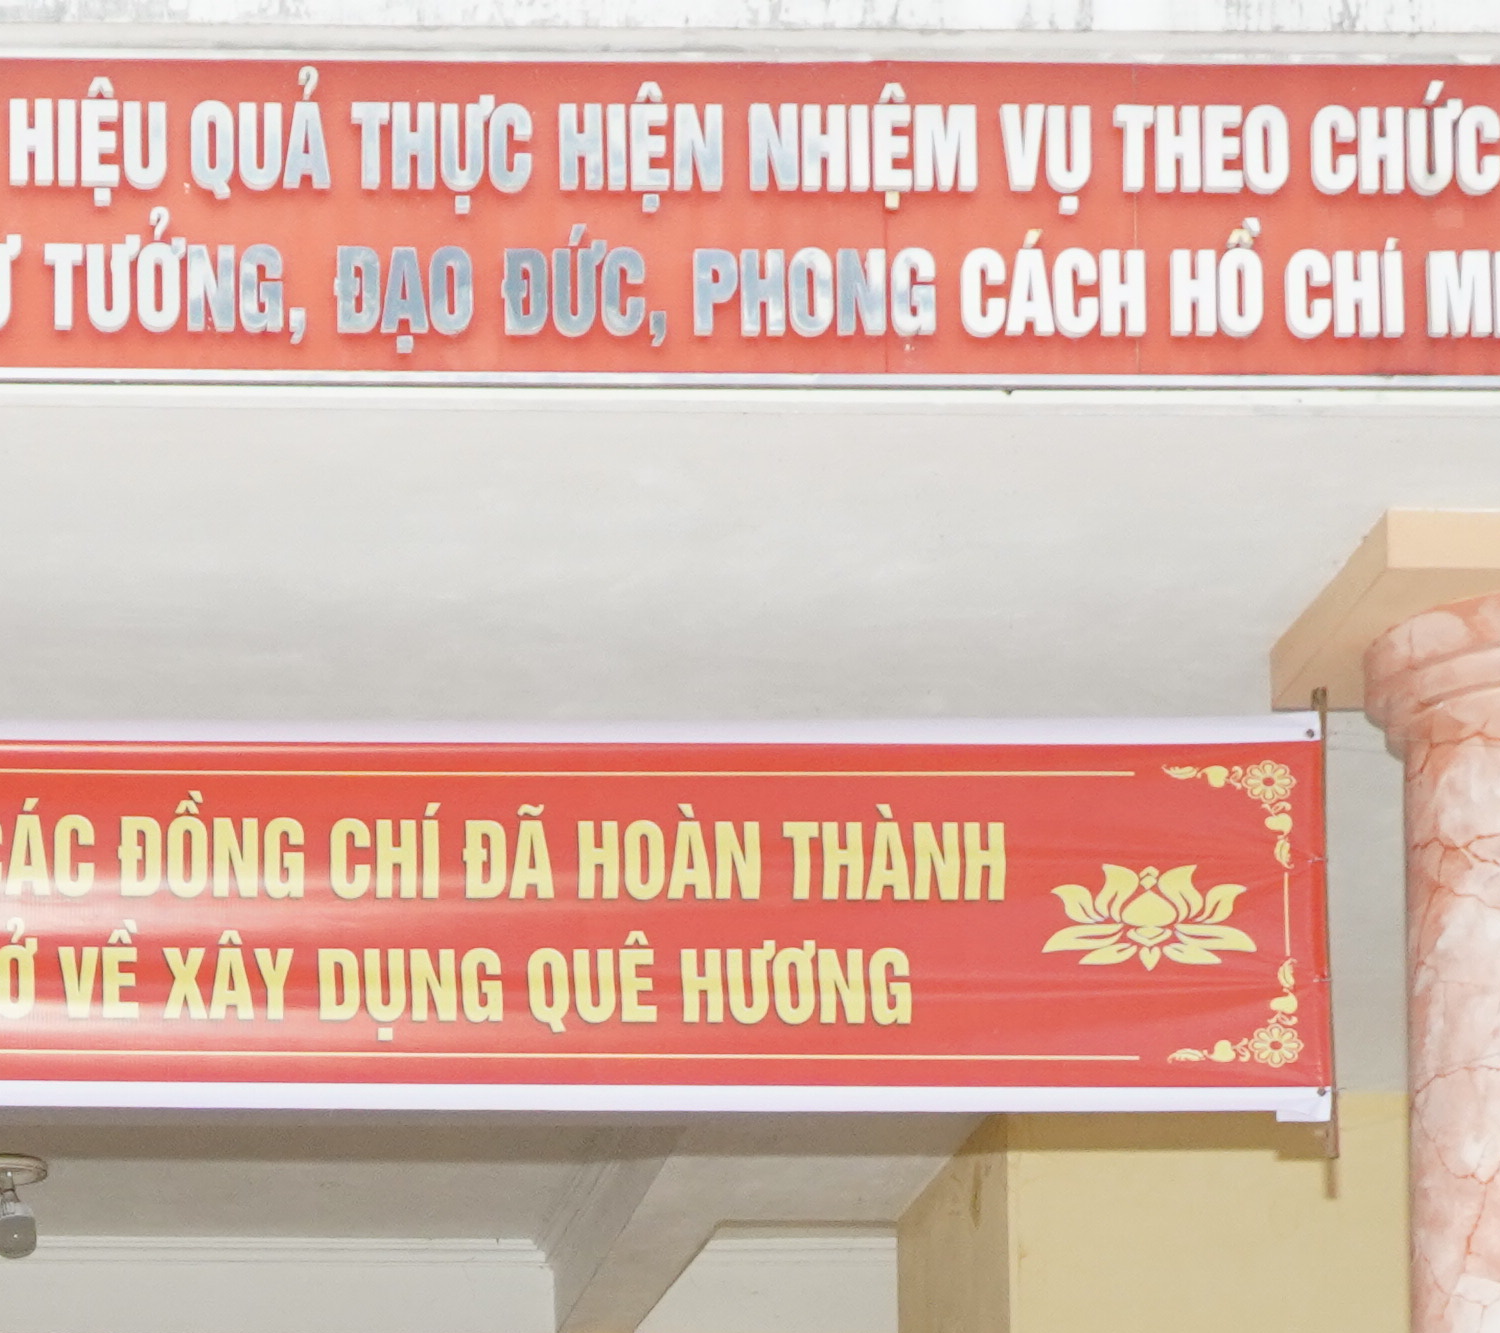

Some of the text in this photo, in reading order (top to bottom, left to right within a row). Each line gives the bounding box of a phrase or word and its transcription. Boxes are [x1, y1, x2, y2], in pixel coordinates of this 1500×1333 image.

[9, 76, 168, 207] HIỆU
[189, 65, 331, 200] QUẢ
[350, 93, 533, 215] THỰC
[558, 81, 723, 213] HIỆN
[748, 82, 978, 213] NHIỆM
[1000, 102, 1093, 216] VỤ
[1112, 102, 1290, 195] THEO
[44, 205, 306, 346] TƯỞNG,
[333, 243, 472, 355] ĐẠO
[502, 222, 667, 347] ĐỨC,
[692, 247, 936, 340] PHONG
[960, 227, 1146, 340] CÁCH
[1170, 217, 1263, 341] HỒ
[1284, 237, 1405, 339] CHÍ
[119, 790, 305, 901] ĐỒNG
[330, 802, 441, 901] CHÍ
[462, 803, 555, 902] ĐÃ
[578, 803, 761, 902] HOÀN
[783, 803, 1006, 902] THÀNH
[55, 918, 140, 1022] VỀ
[162, 930, 294, 1022] XÂY
[319, 947, 503, 1041] DỤNG
[527, 930, 658, 1033] QUÊ
[682, 939, 912, 1026] HƯƠNG
